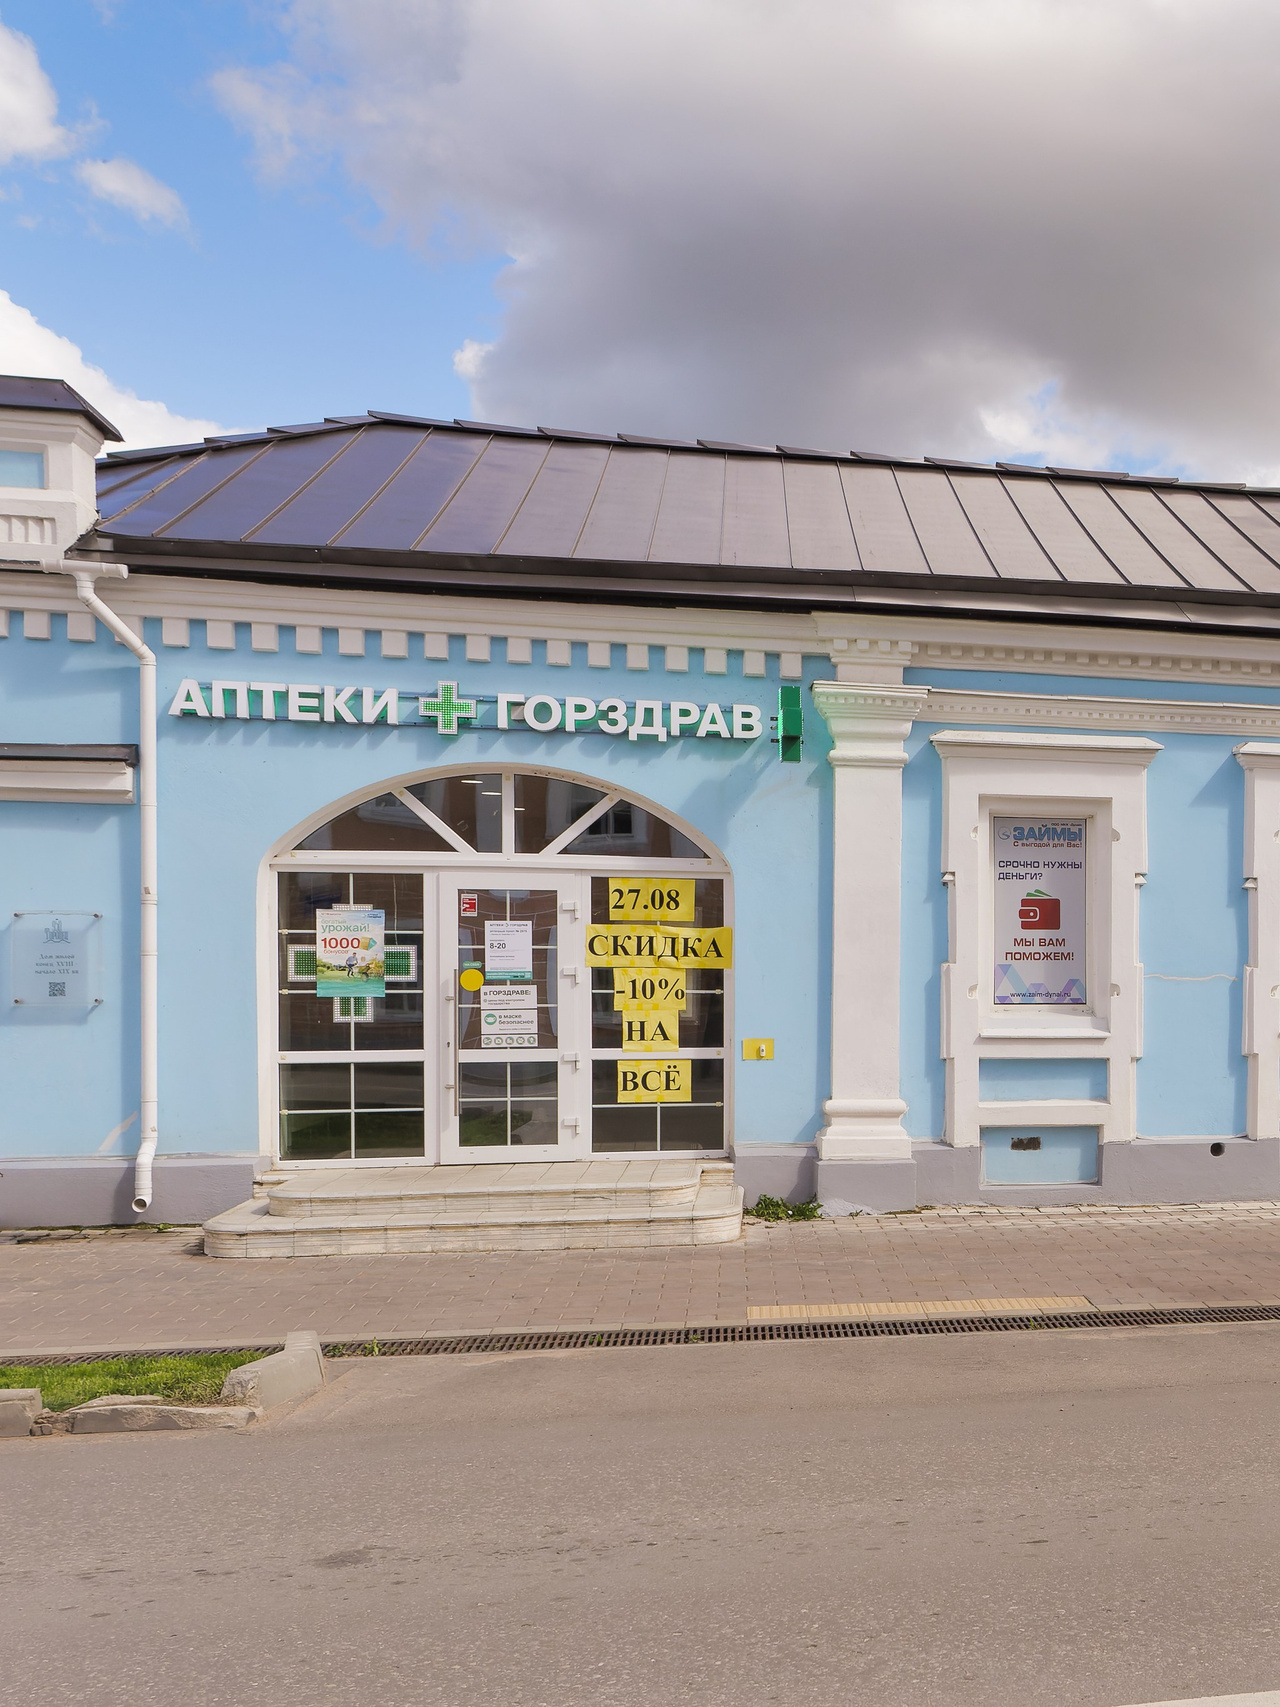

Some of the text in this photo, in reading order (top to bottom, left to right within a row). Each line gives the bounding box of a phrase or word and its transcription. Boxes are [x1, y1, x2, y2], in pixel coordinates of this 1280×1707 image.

[169, 678, 764, 742] АПТЕКИ ГОРЗДРАВ
[1012, 823, 1083, 841] ЗАЙМЫ
[998, 860, 1083, 869] СРОЧНО НУЖНЫ
[997, 872, 1043, 880] ДЕНЬГИ?
[611, 888, 680, 910] 27.08
[321, 922, 370, 934] урожай!
[321, 937, 361, 949] 1000
[588, 934, 723, 962] СКИДКА
[1013, 938, 1066, 947] МЫ ВАМ
[1005, 951, 1075, 961] ПОМОЖЕМ!
[616, 977, 685, 1001] -10%
[624, 1020, 671, 1042] НА
[619, 1064, 682, 1092] ВСЁ
